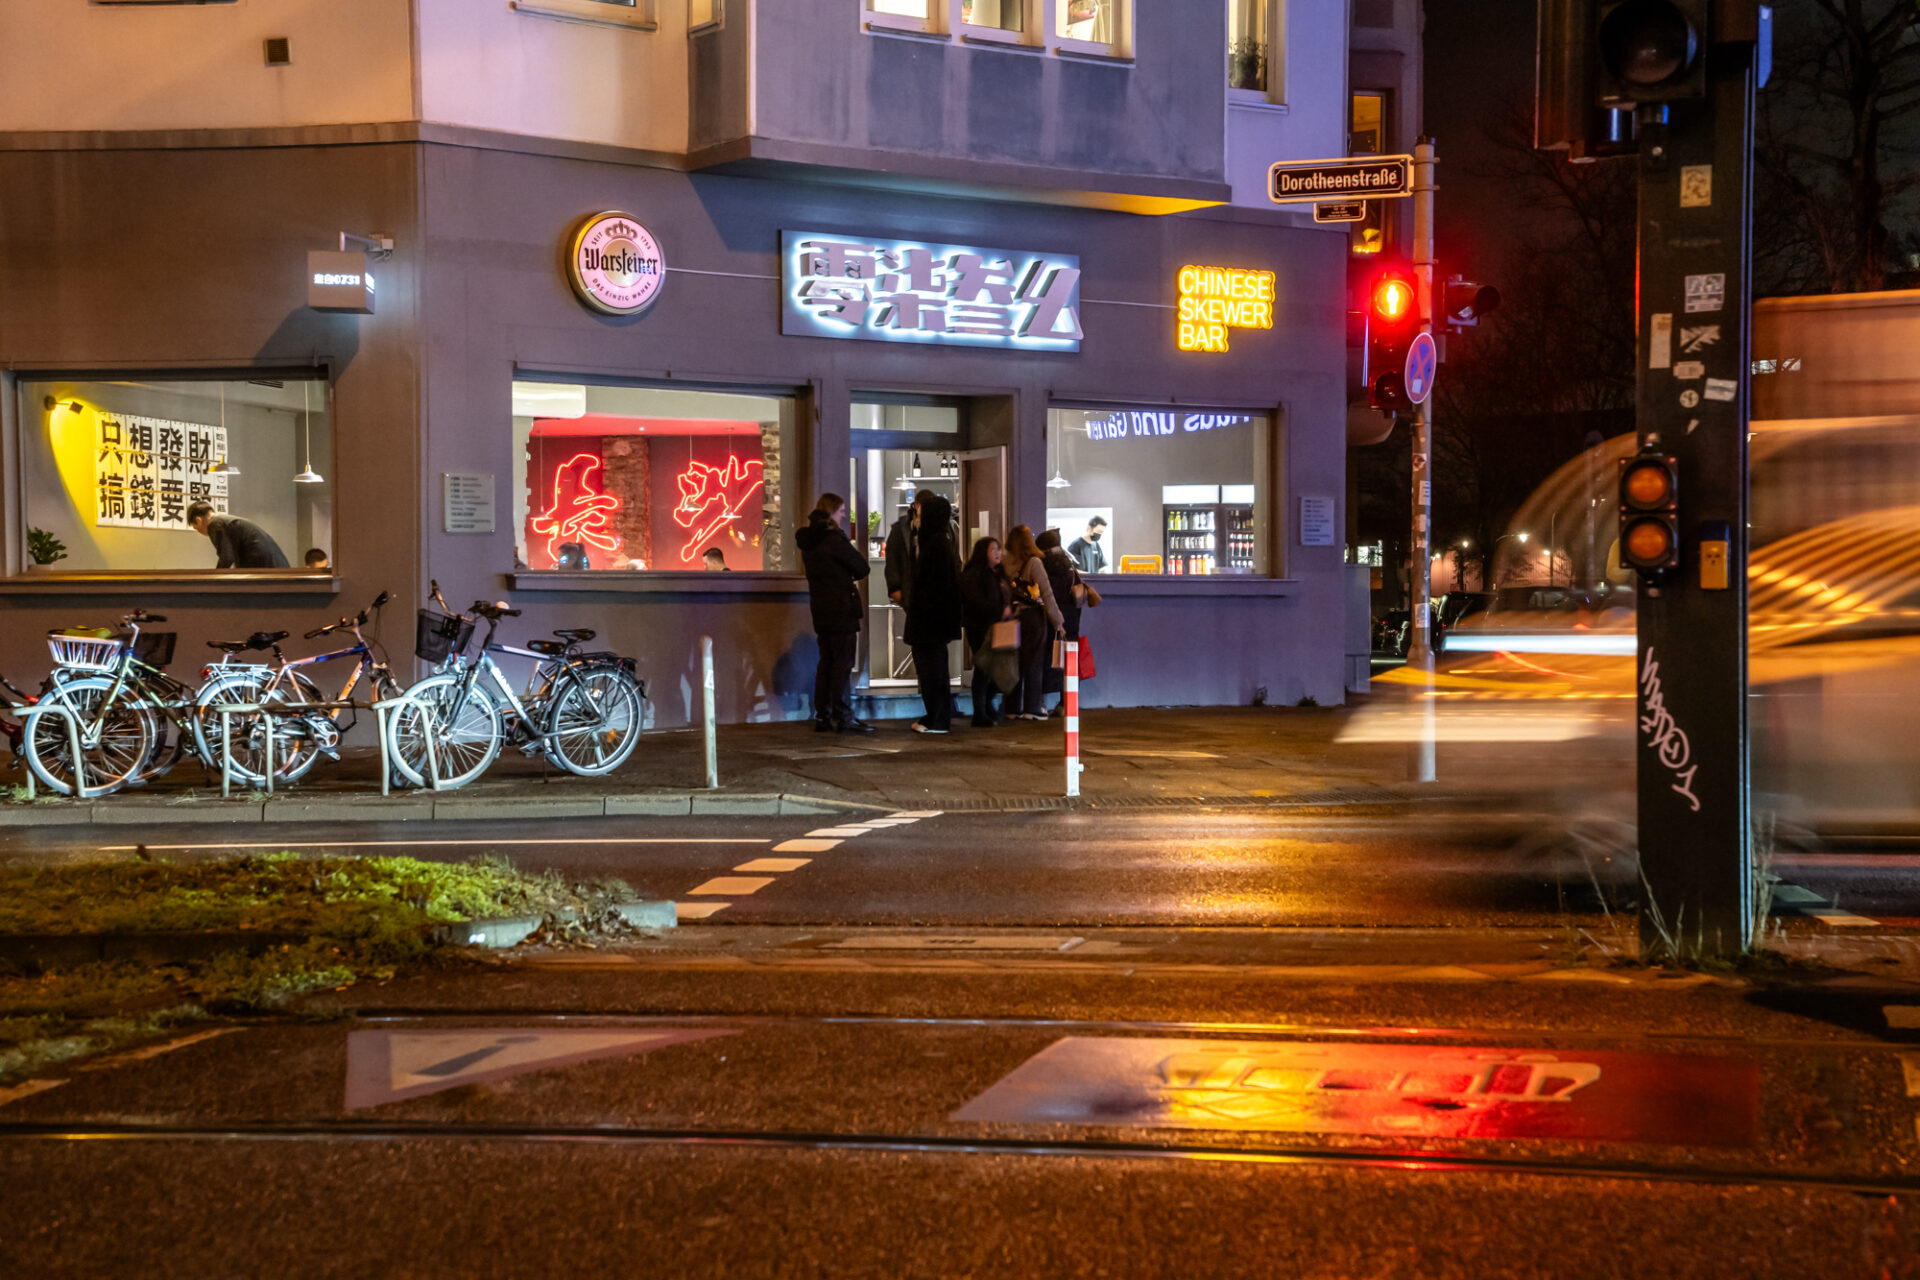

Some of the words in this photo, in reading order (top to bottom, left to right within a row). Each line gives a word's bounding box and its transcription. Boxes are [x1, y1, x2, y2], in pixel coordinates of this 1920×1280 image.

[1281, 168, 1397, 191] Dorotheenstraße
[591, 231, 603, 245] SEIT
[584, 247, 658, 275] Warsteiner
[592, 278, 605, 292] DAS
[605, 290, 630, 301] EINZIG
[632, 281, 652, 299] WAHRE
[1180, 269, 1271, 299] CHINESE
[1180, 297, 1268, 326] SKEWER
[1180, 323, 1224, 350] BAR
[98, 420, 212, 474] 只想發財
